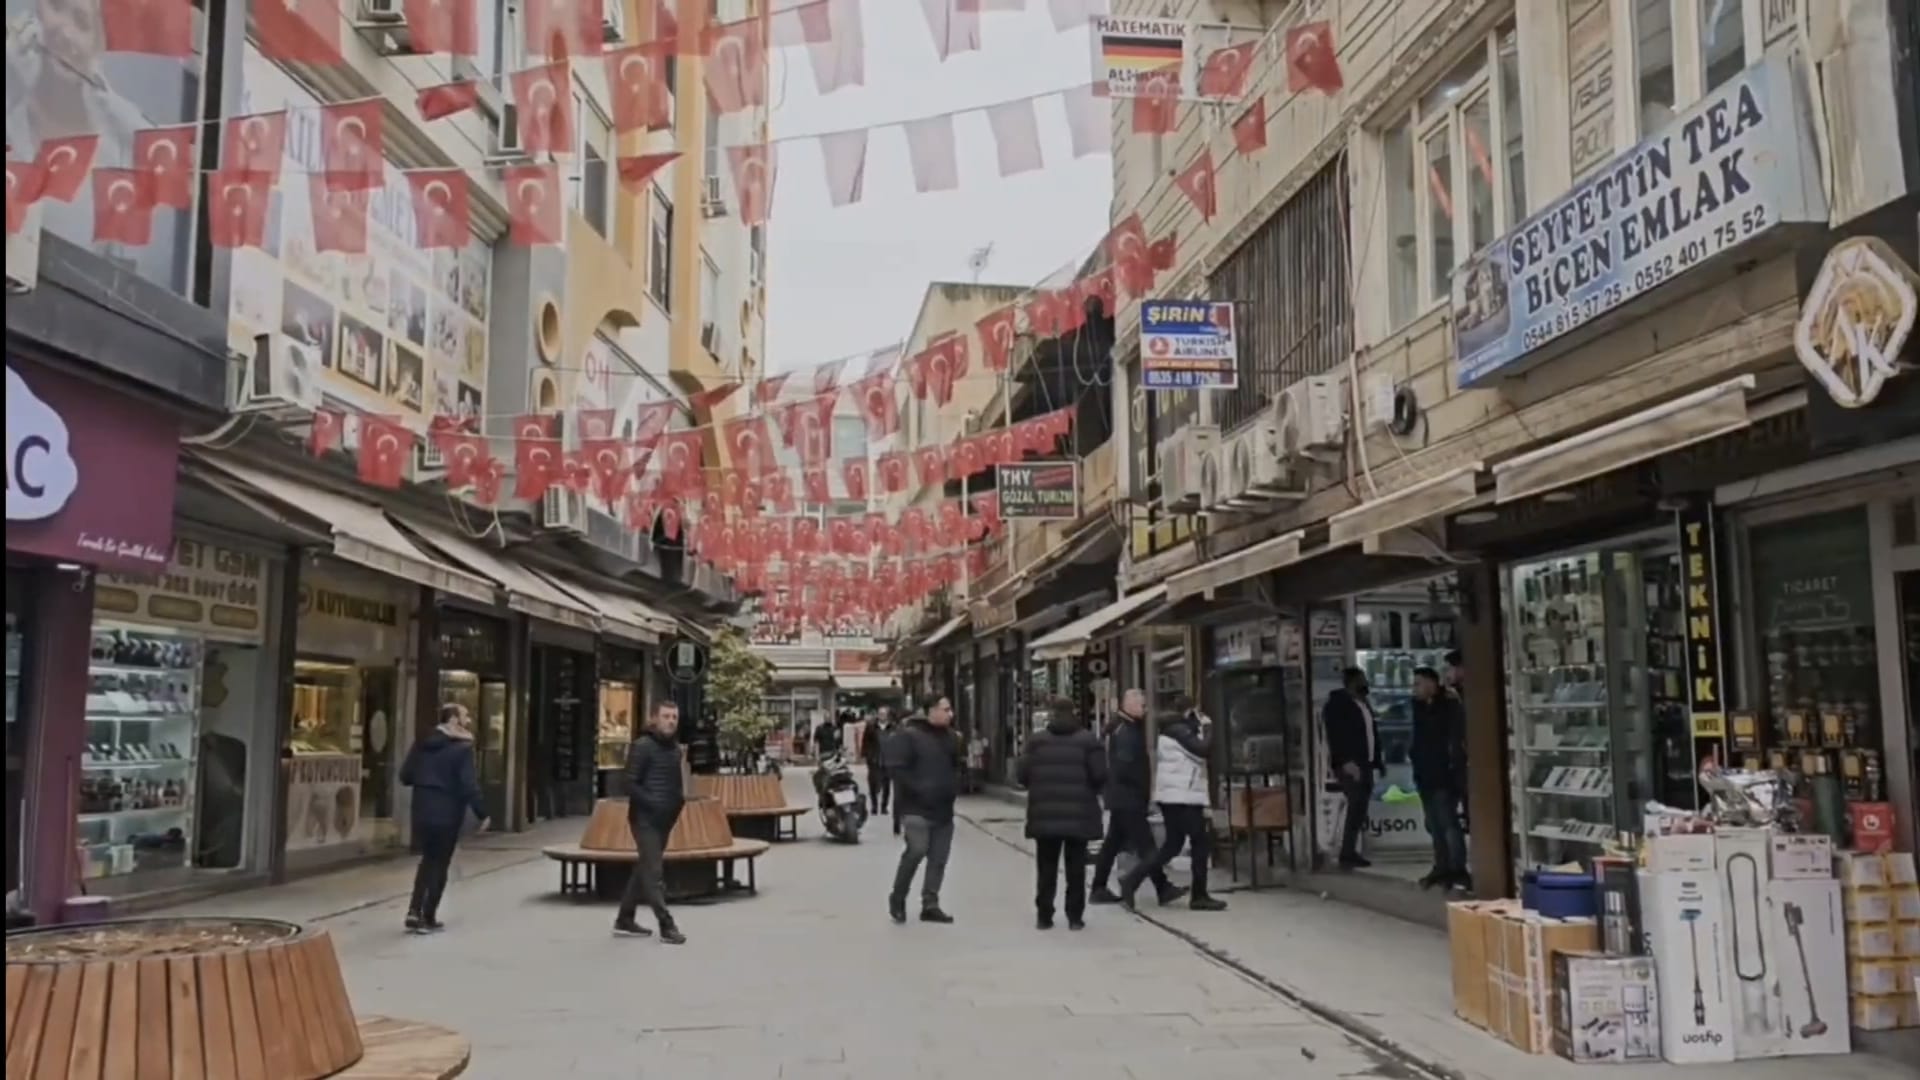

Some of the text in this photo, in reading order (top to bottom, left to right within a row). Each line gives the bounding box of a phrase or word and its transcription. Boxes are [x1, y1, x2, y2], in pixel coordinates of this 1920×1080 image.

[1683, 84, 1762, 165] TEA
[1619, 149, 1751, 261] EMLAK
[1523, 324, 1553, 351] 0544
[1556, 306, 1580, 337] 815
[1584, 296, 1600, 324] 37
[1603, 281, 1622, 309] 25
[1634, 257, 1674, 292] 0552
[1678, 239, 1708, 269] 401
[1713, 224, 1737, 250] 75
[1742, 204, 1767, 234] 52
[1174, 347, 1228, 356] AIRLINES
[6, 435, 50, 498] C
[1001, 469, 1031, 486] THY
